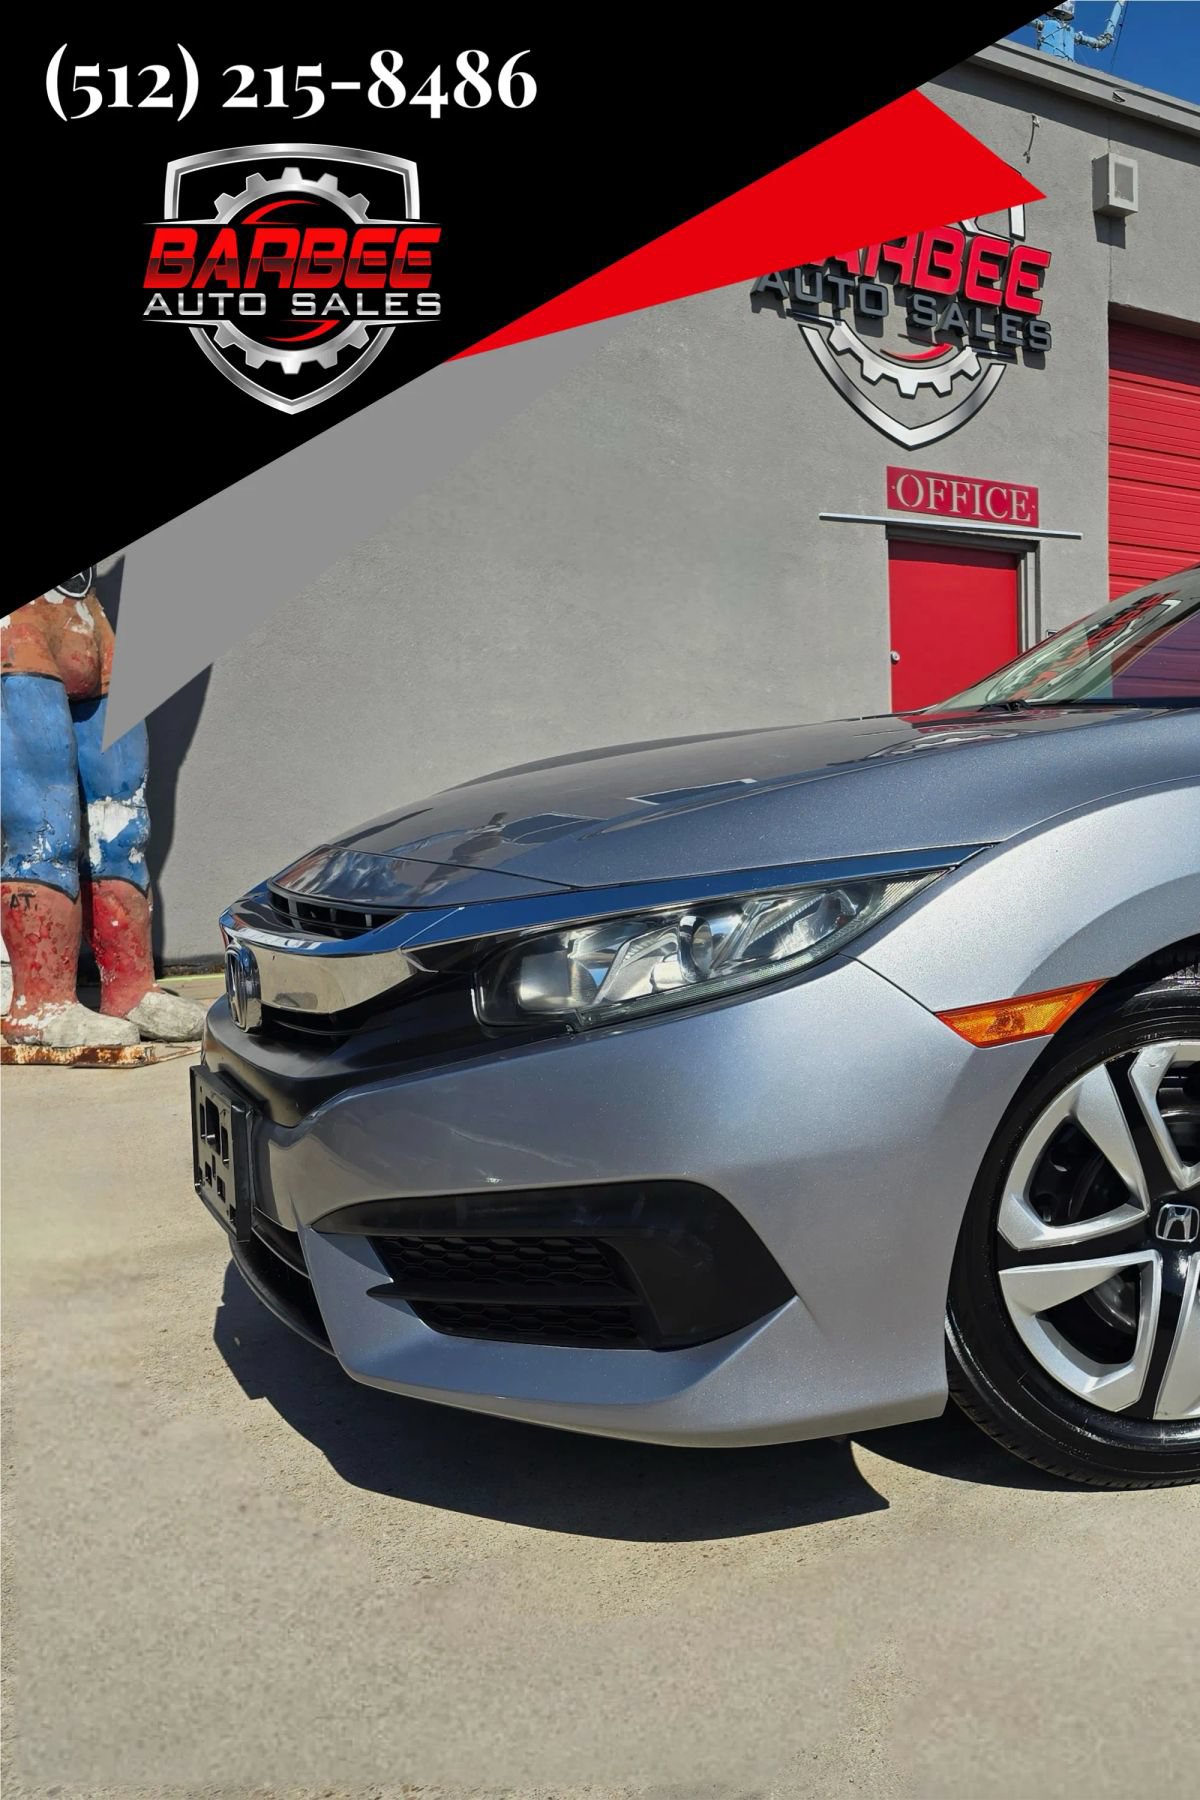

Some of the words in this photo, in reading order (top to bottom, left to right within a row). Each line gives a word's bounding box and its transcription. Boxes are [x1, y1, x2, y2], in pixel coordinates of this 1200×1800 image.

[752, 267, 889, 317] AUTO
[909, 294, 1052, 351] SALES
[896, 474, 1031, 522] OFFICE
